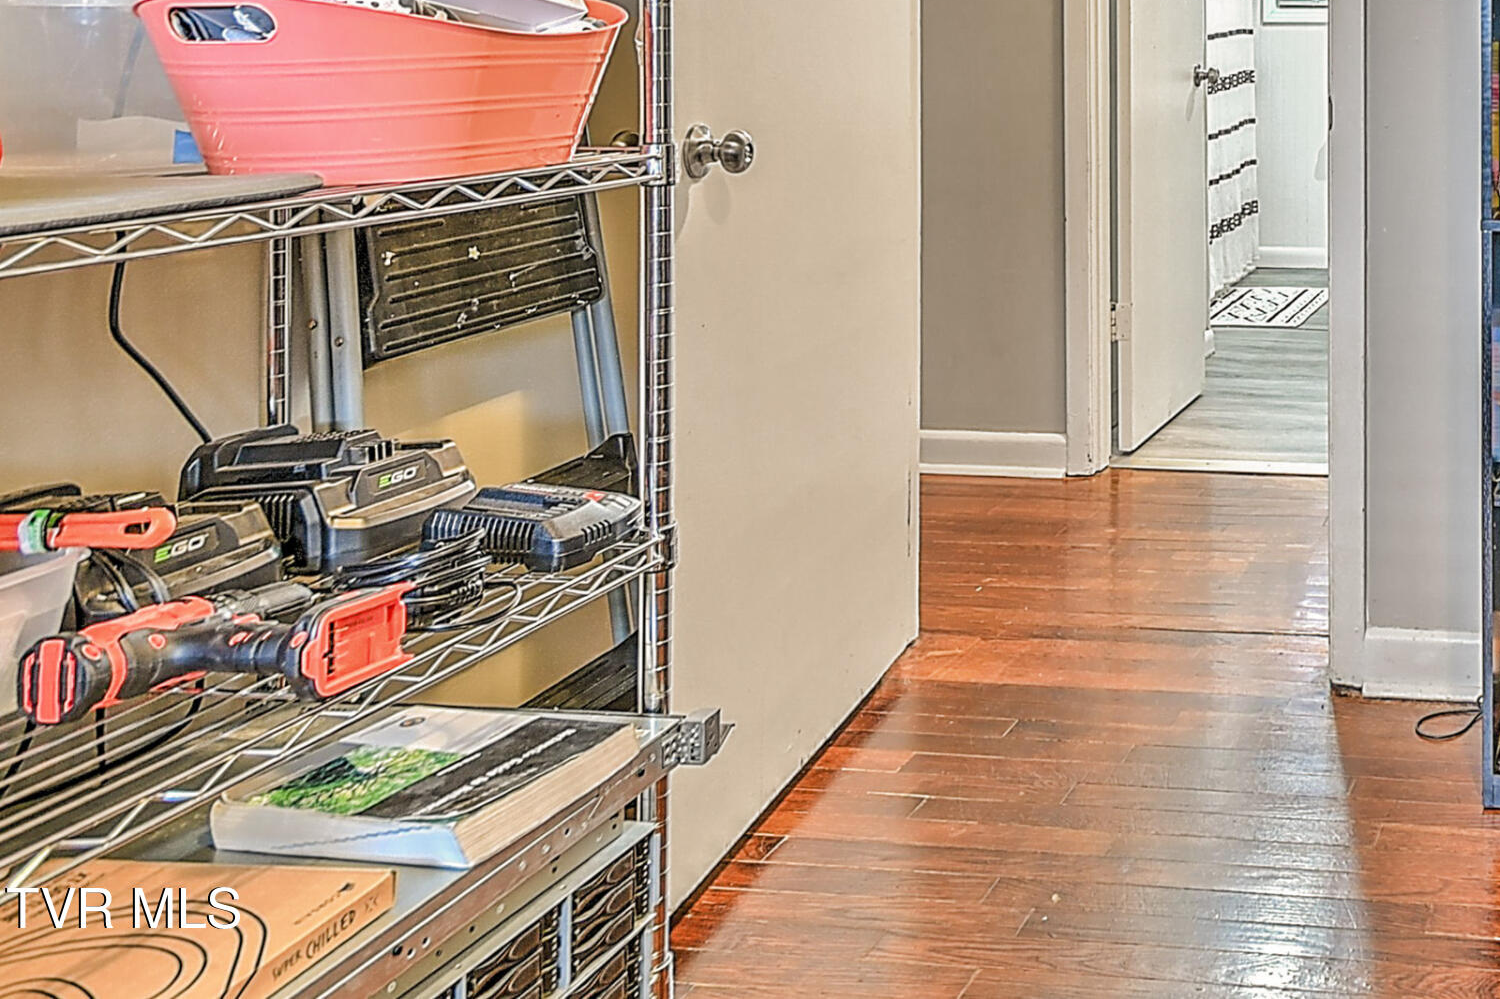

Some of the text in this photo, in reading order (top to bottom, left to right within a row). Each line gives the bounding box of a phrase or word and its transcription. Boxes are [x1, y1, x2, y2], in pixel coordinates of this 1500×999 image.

[378, 467, 416, 489] EGO
[154, 534, 206, 563] EGO
[272, 909, 356, 980] SUPER CHILLED
